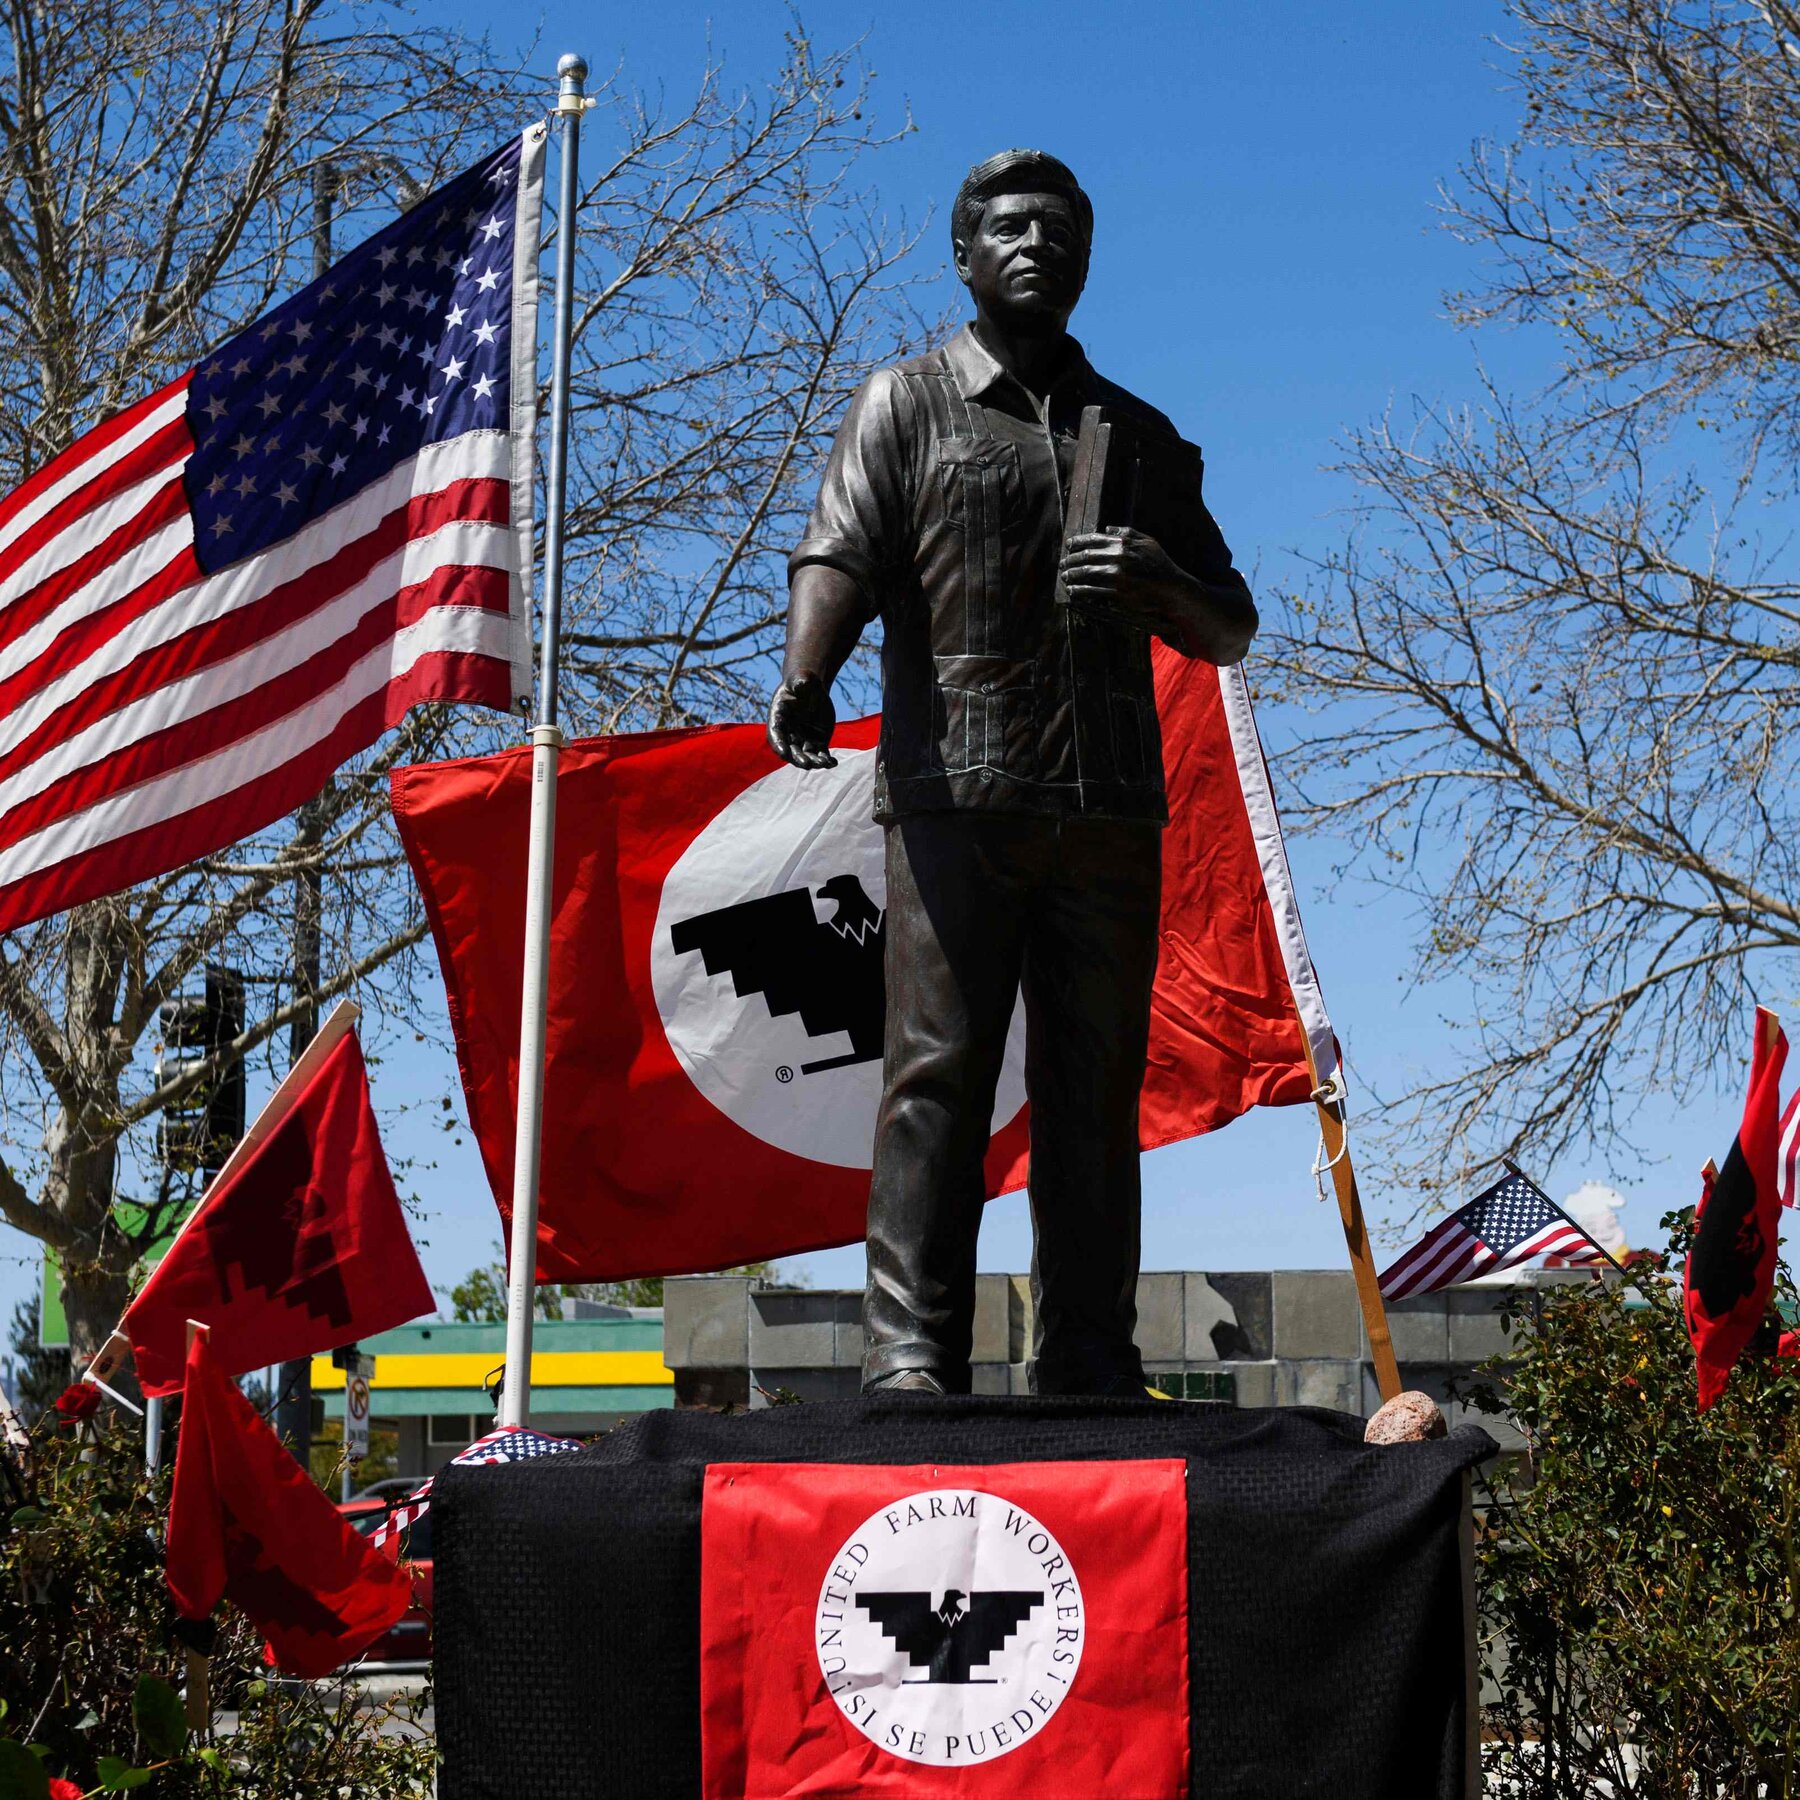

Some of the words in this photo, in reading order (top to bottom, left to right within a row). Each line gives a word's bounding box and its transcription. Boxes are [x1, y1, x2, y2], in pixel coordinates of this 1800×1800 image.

[821, 1543, 869, 1678] UNITED
[883, 1495, 978, 1535] FARM
[1003, 1508, 1080, 1666] WORKERS
[885, 1723, 927, 1756] SE
